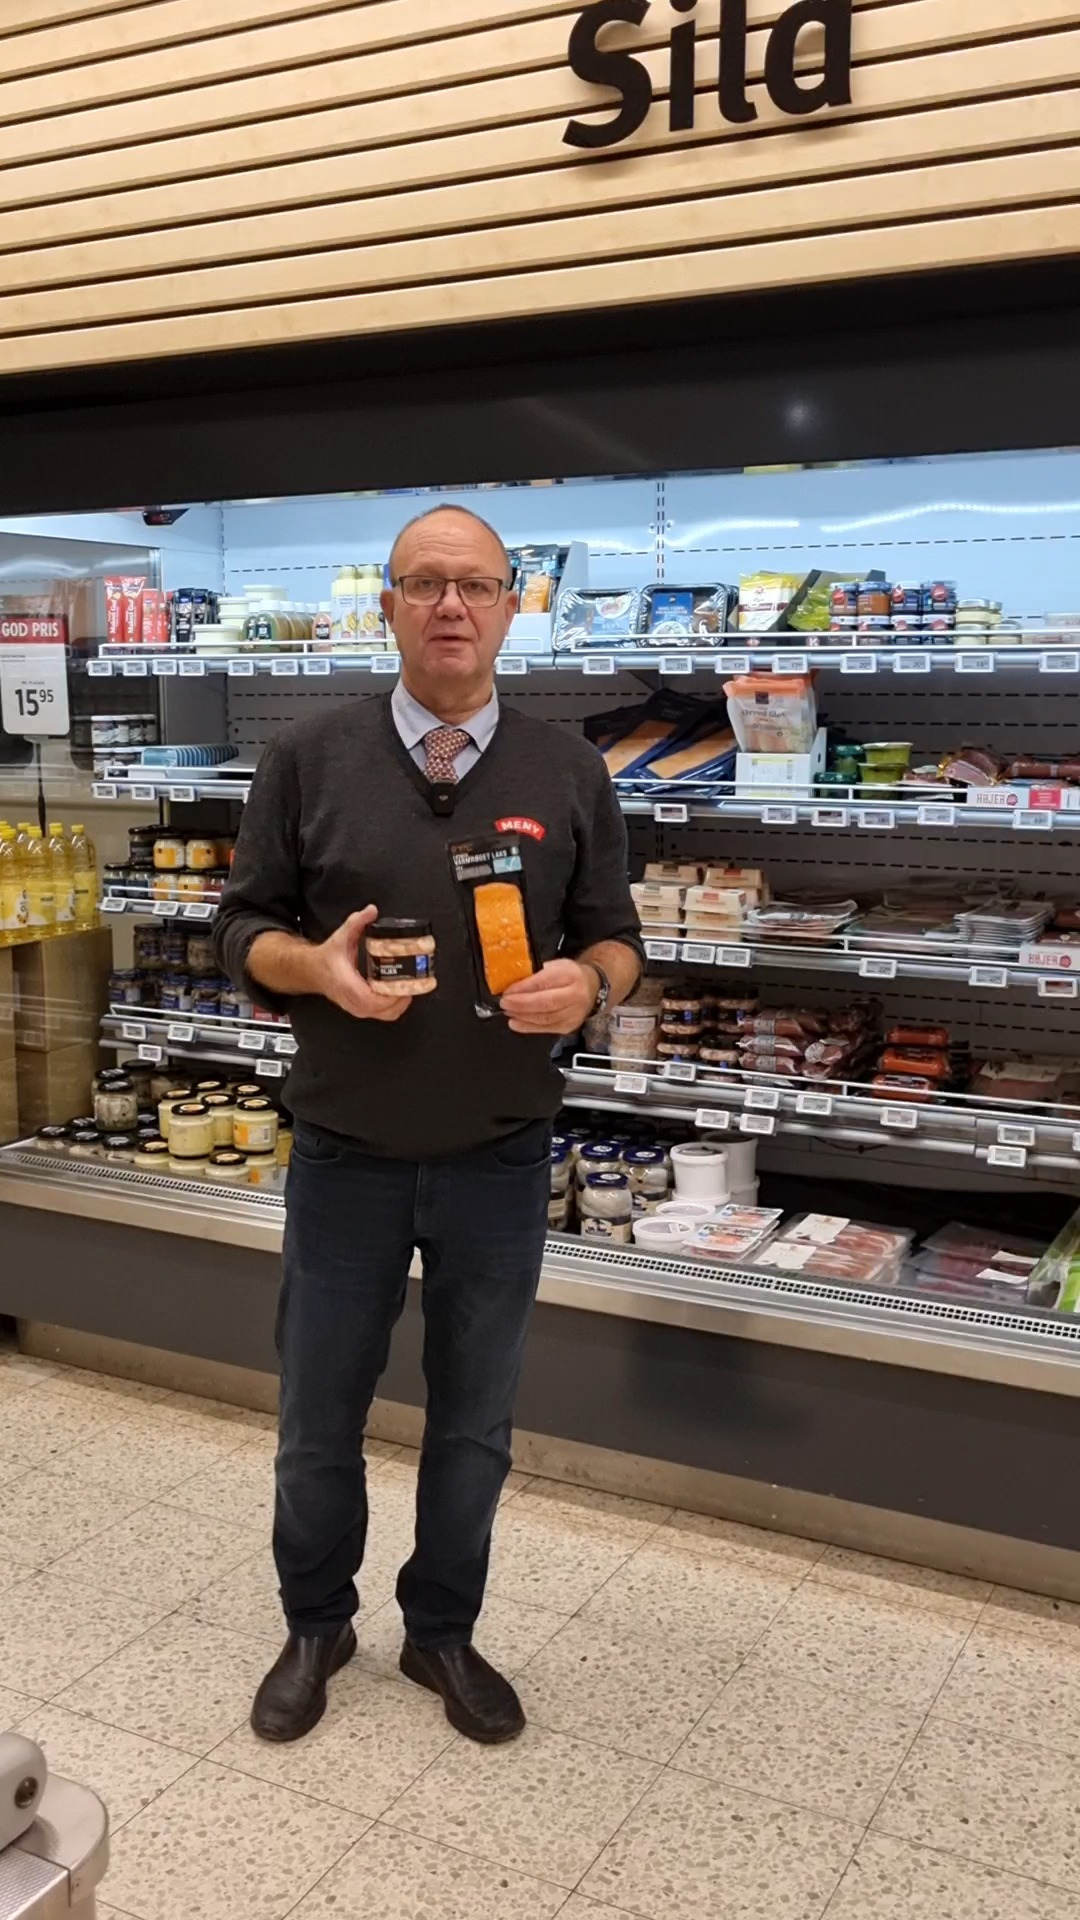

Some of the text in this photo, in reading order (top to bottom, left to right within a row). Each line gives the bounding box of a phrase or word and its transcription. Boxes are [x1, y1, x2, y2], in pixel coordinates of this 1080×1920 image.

[1, 622, 59, 637] GOD PRIS
[501, 820, 541, 834] MENY
